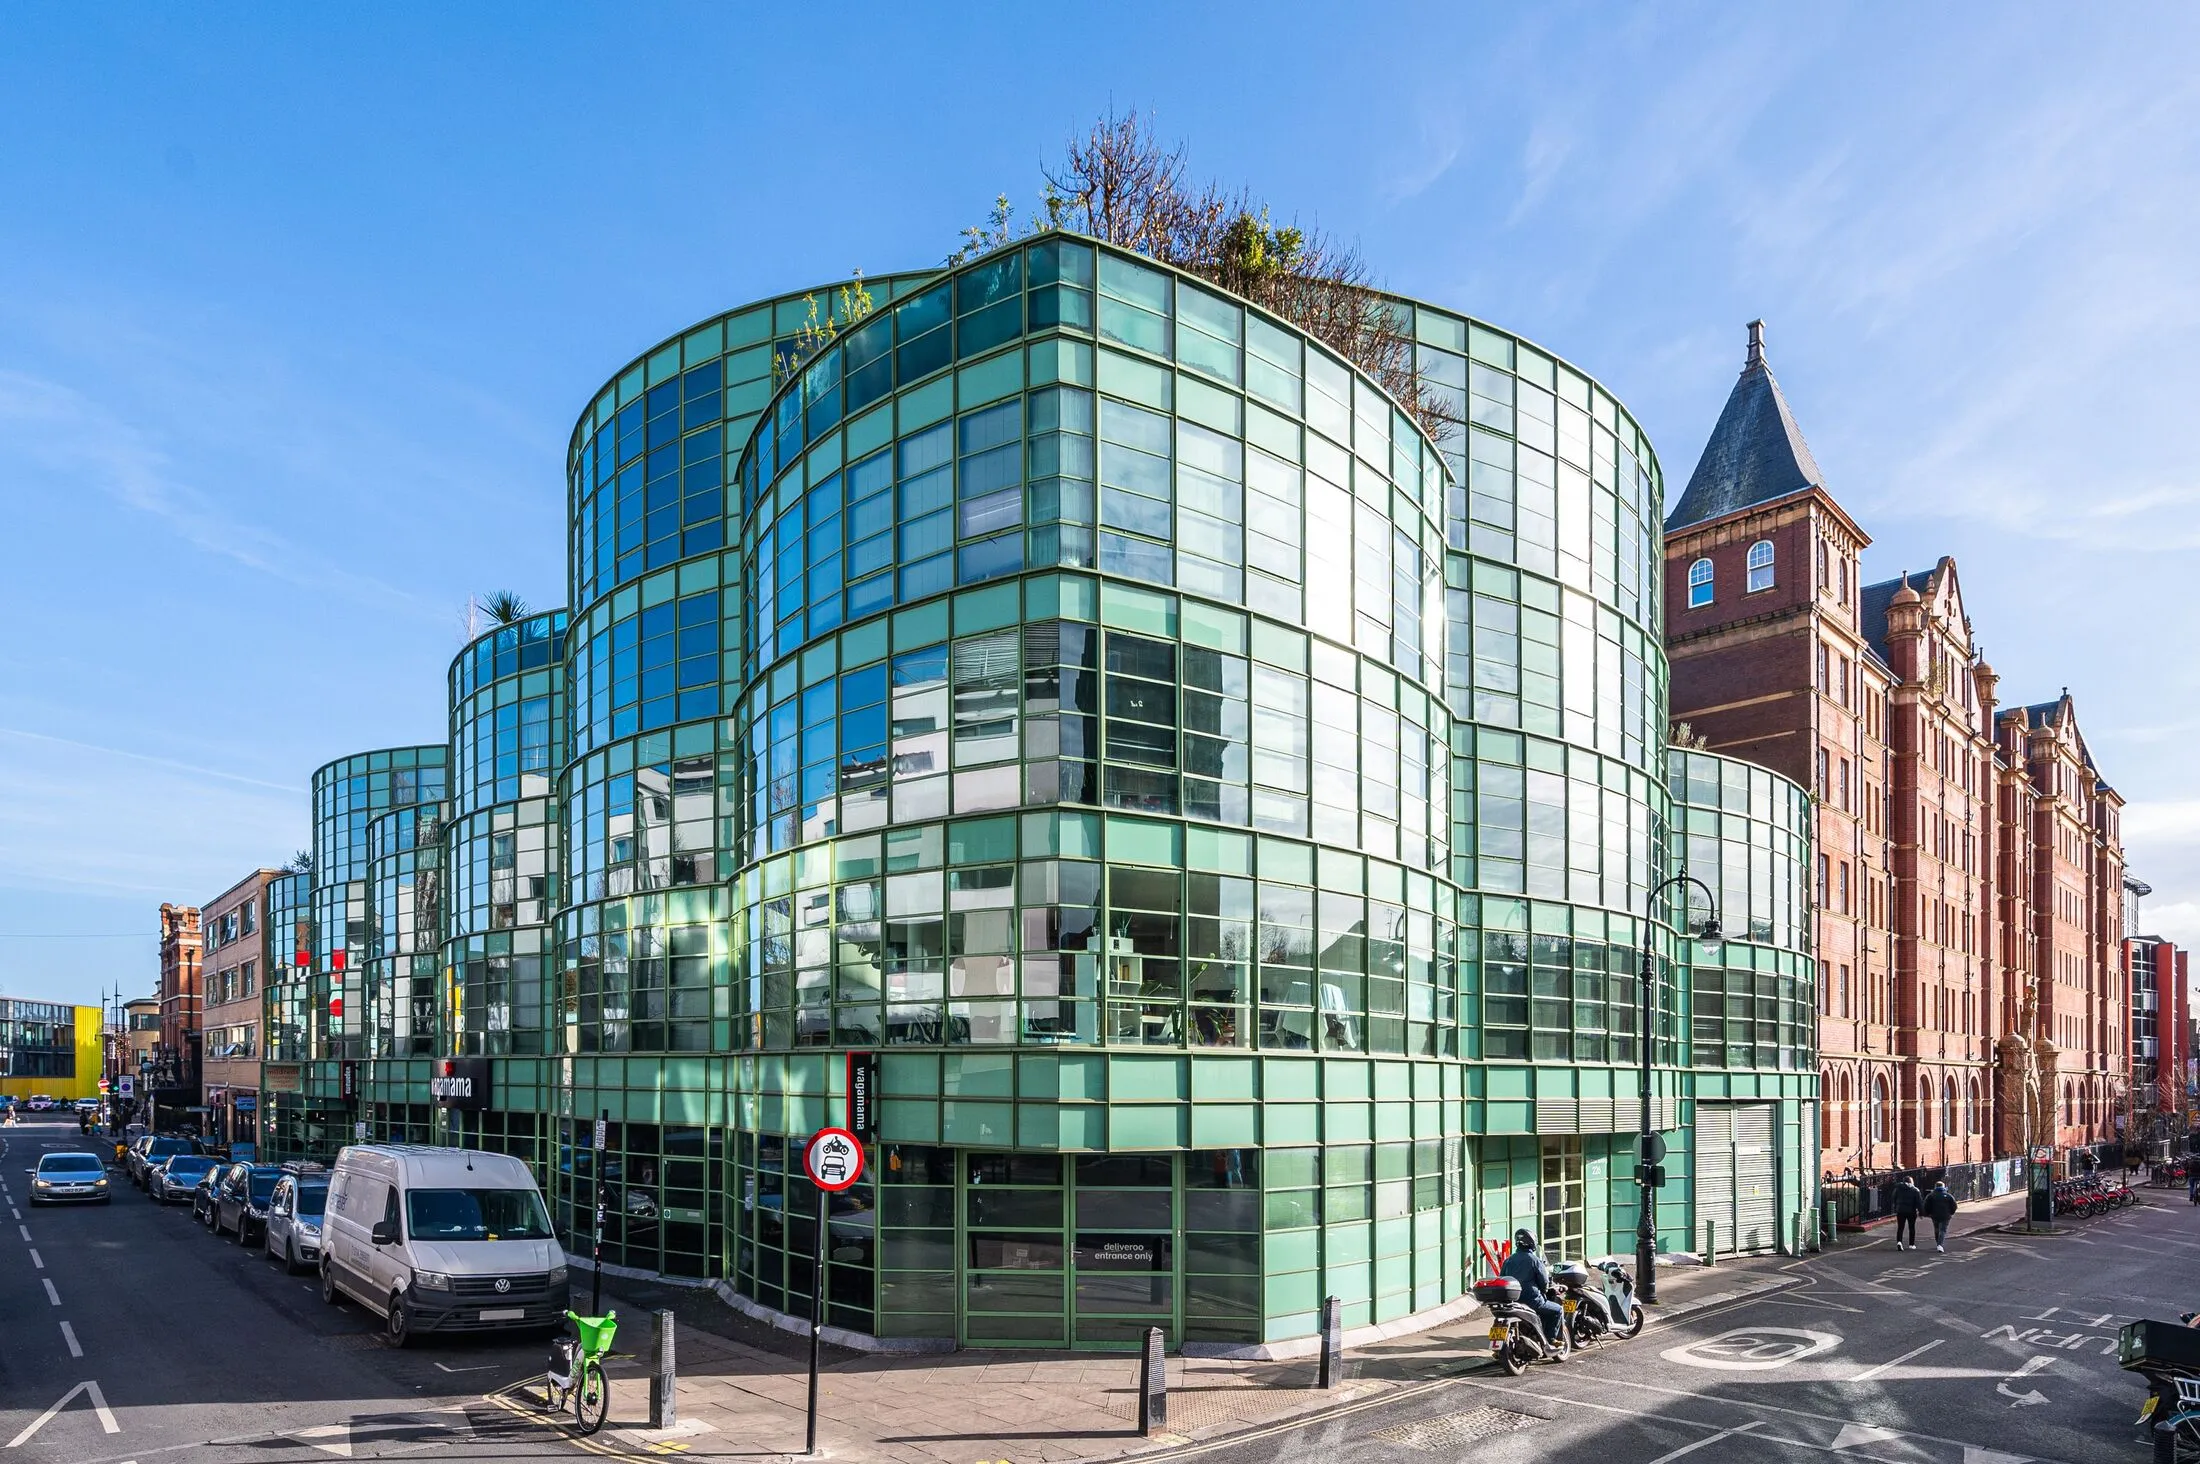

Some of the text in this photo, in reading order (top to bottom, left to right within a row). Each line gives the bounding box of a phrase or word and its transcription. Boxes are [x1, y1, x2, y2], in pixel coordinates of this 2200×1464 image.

[855, 1066, 865, 1130] wagamama
[1094, 1252, 1153, 1262] entrance only
[1103, 1243, 1145, 1251] deliveroo
[1696, 1337, 1806, 1360] 20
[1980, 1324, 2120, 1355] URN
